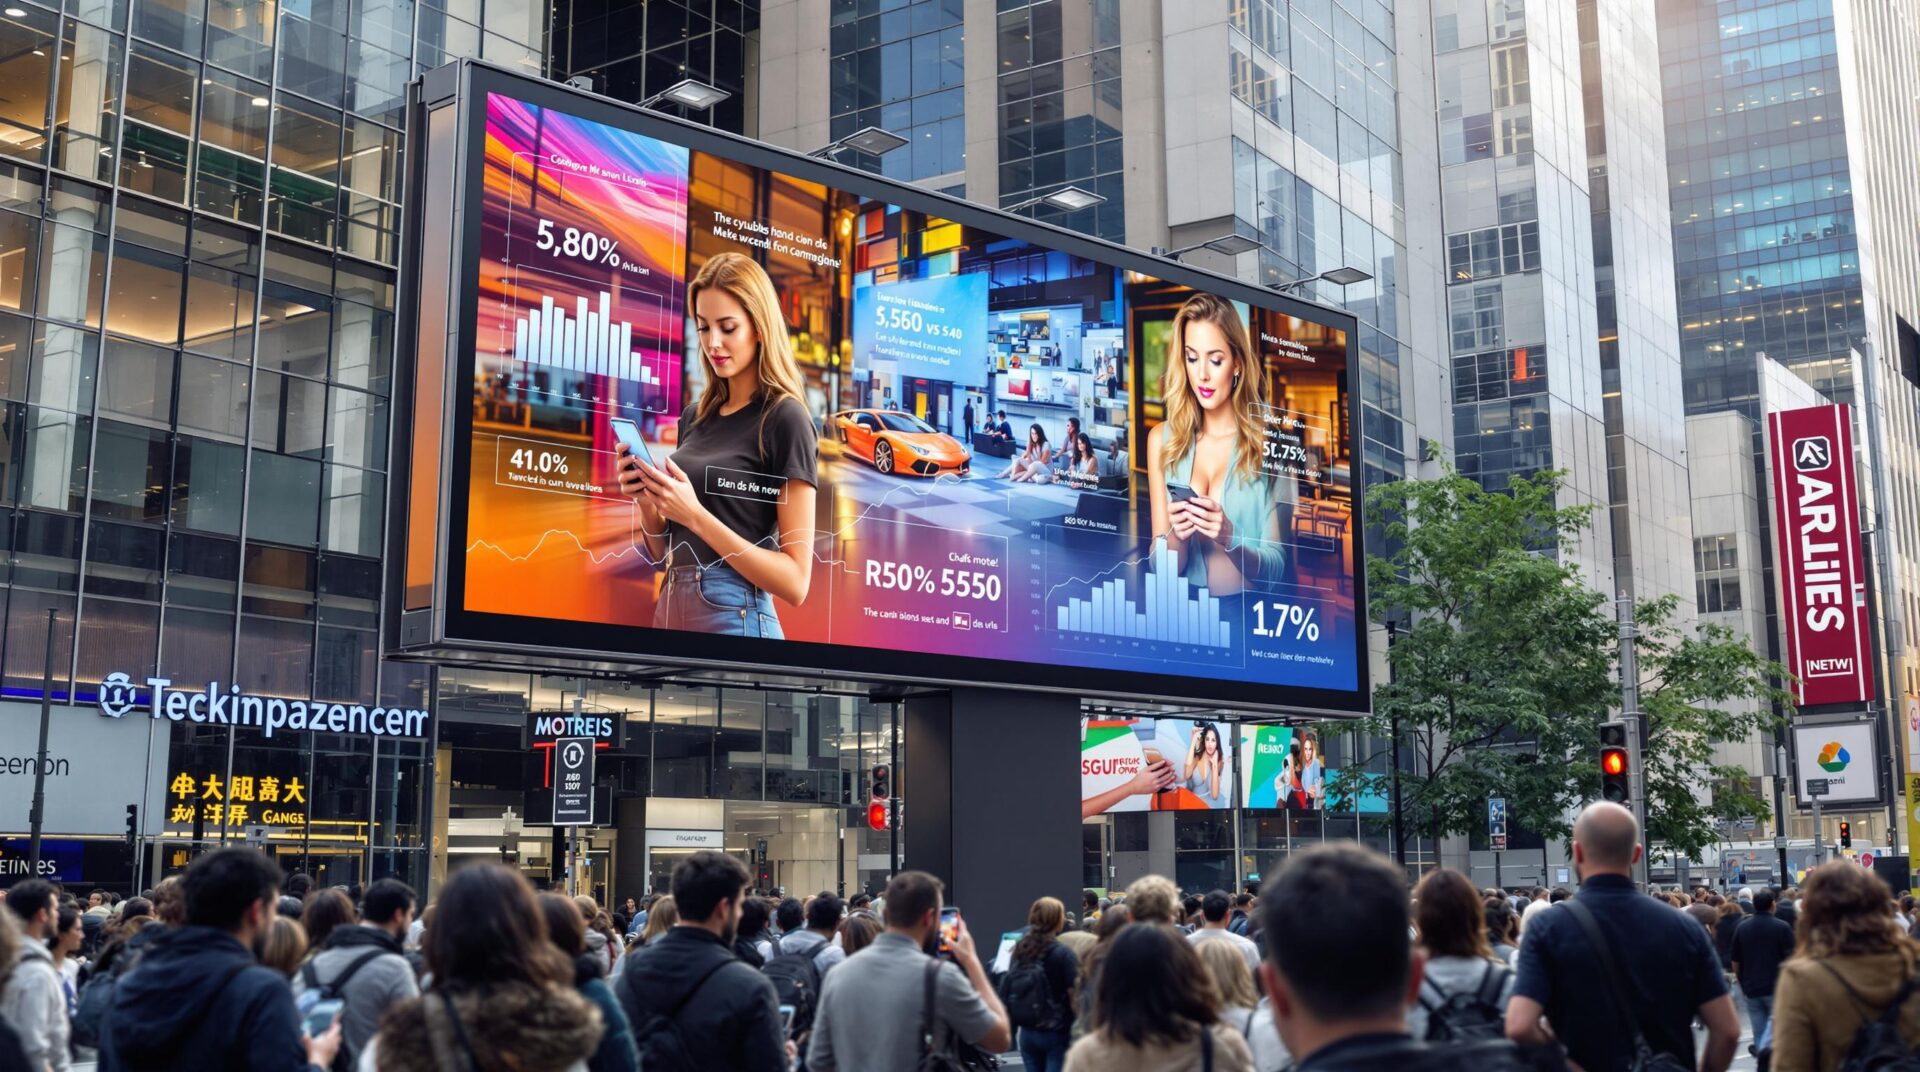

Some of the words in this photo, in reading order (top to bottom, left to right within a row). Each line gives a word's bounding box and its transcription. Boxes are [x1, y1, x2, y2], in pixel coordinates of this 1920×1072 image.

[713, 211, 732, 225] The
[536, 218, 620, 267] 5,80%
[510, 448, 569, 475] 41.0%
[865, 559, 936, 594] R50%
[940, 568, 1002, 602] 5550
[864, 607, 879, 618] The
[1252, 600, 1320, 642] 1.7%
[535, 716, 613, 737] MOTREIS
